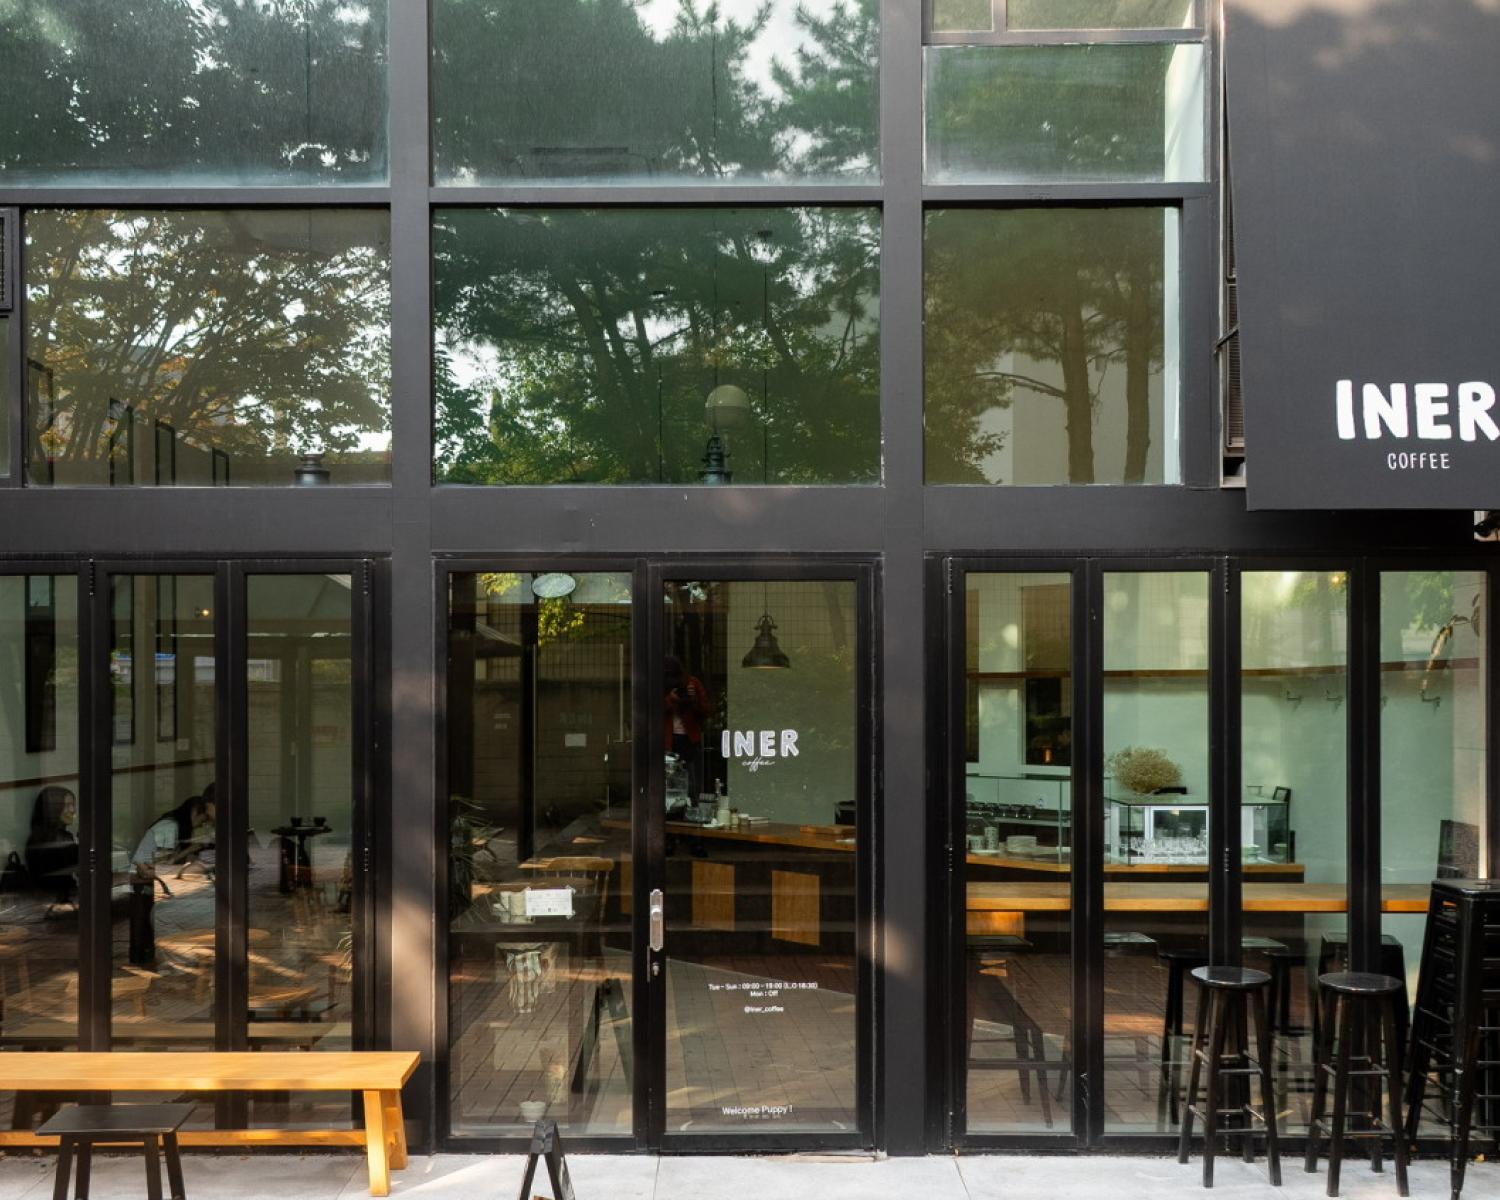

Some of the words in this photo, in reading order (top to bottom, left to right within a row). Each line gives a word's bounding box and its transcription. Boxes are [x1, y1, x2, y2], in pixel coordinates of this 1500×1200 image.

[1336, 379, 1500, 442] INER
[1387, 452, 1450, 470] COFFEE
[721, 729, 800, 758] INER
[741, 756, 776, 772] coffee
[722, 1105, 760, 1116] Welcome
